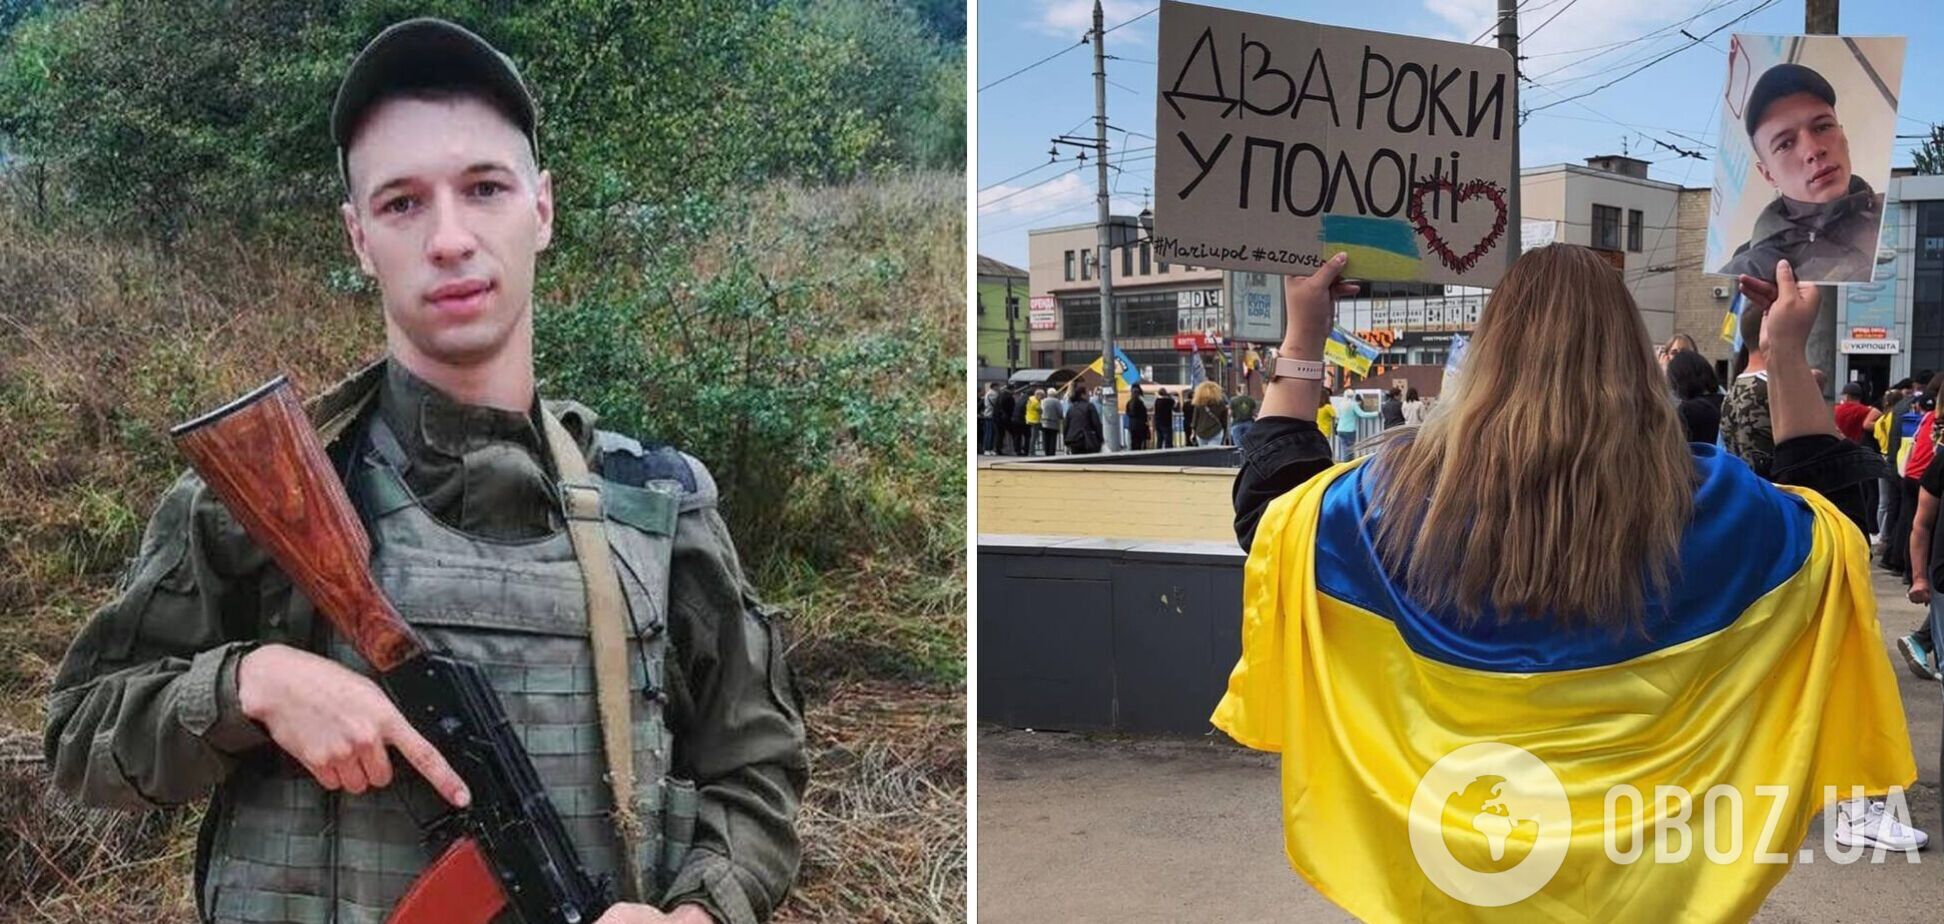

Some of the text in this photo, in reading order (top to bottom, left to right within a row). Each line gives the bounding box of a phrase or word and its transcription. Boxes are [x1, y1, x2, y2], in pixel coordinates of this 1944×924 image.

[1162, 26, 1506, 140] ДВА РОКИ
[1177, 131, 1233, 200] У
[1154, 236, 1249, 262] #Mariupol
[1850, 343, 1897, 351] УКРПОШТА
